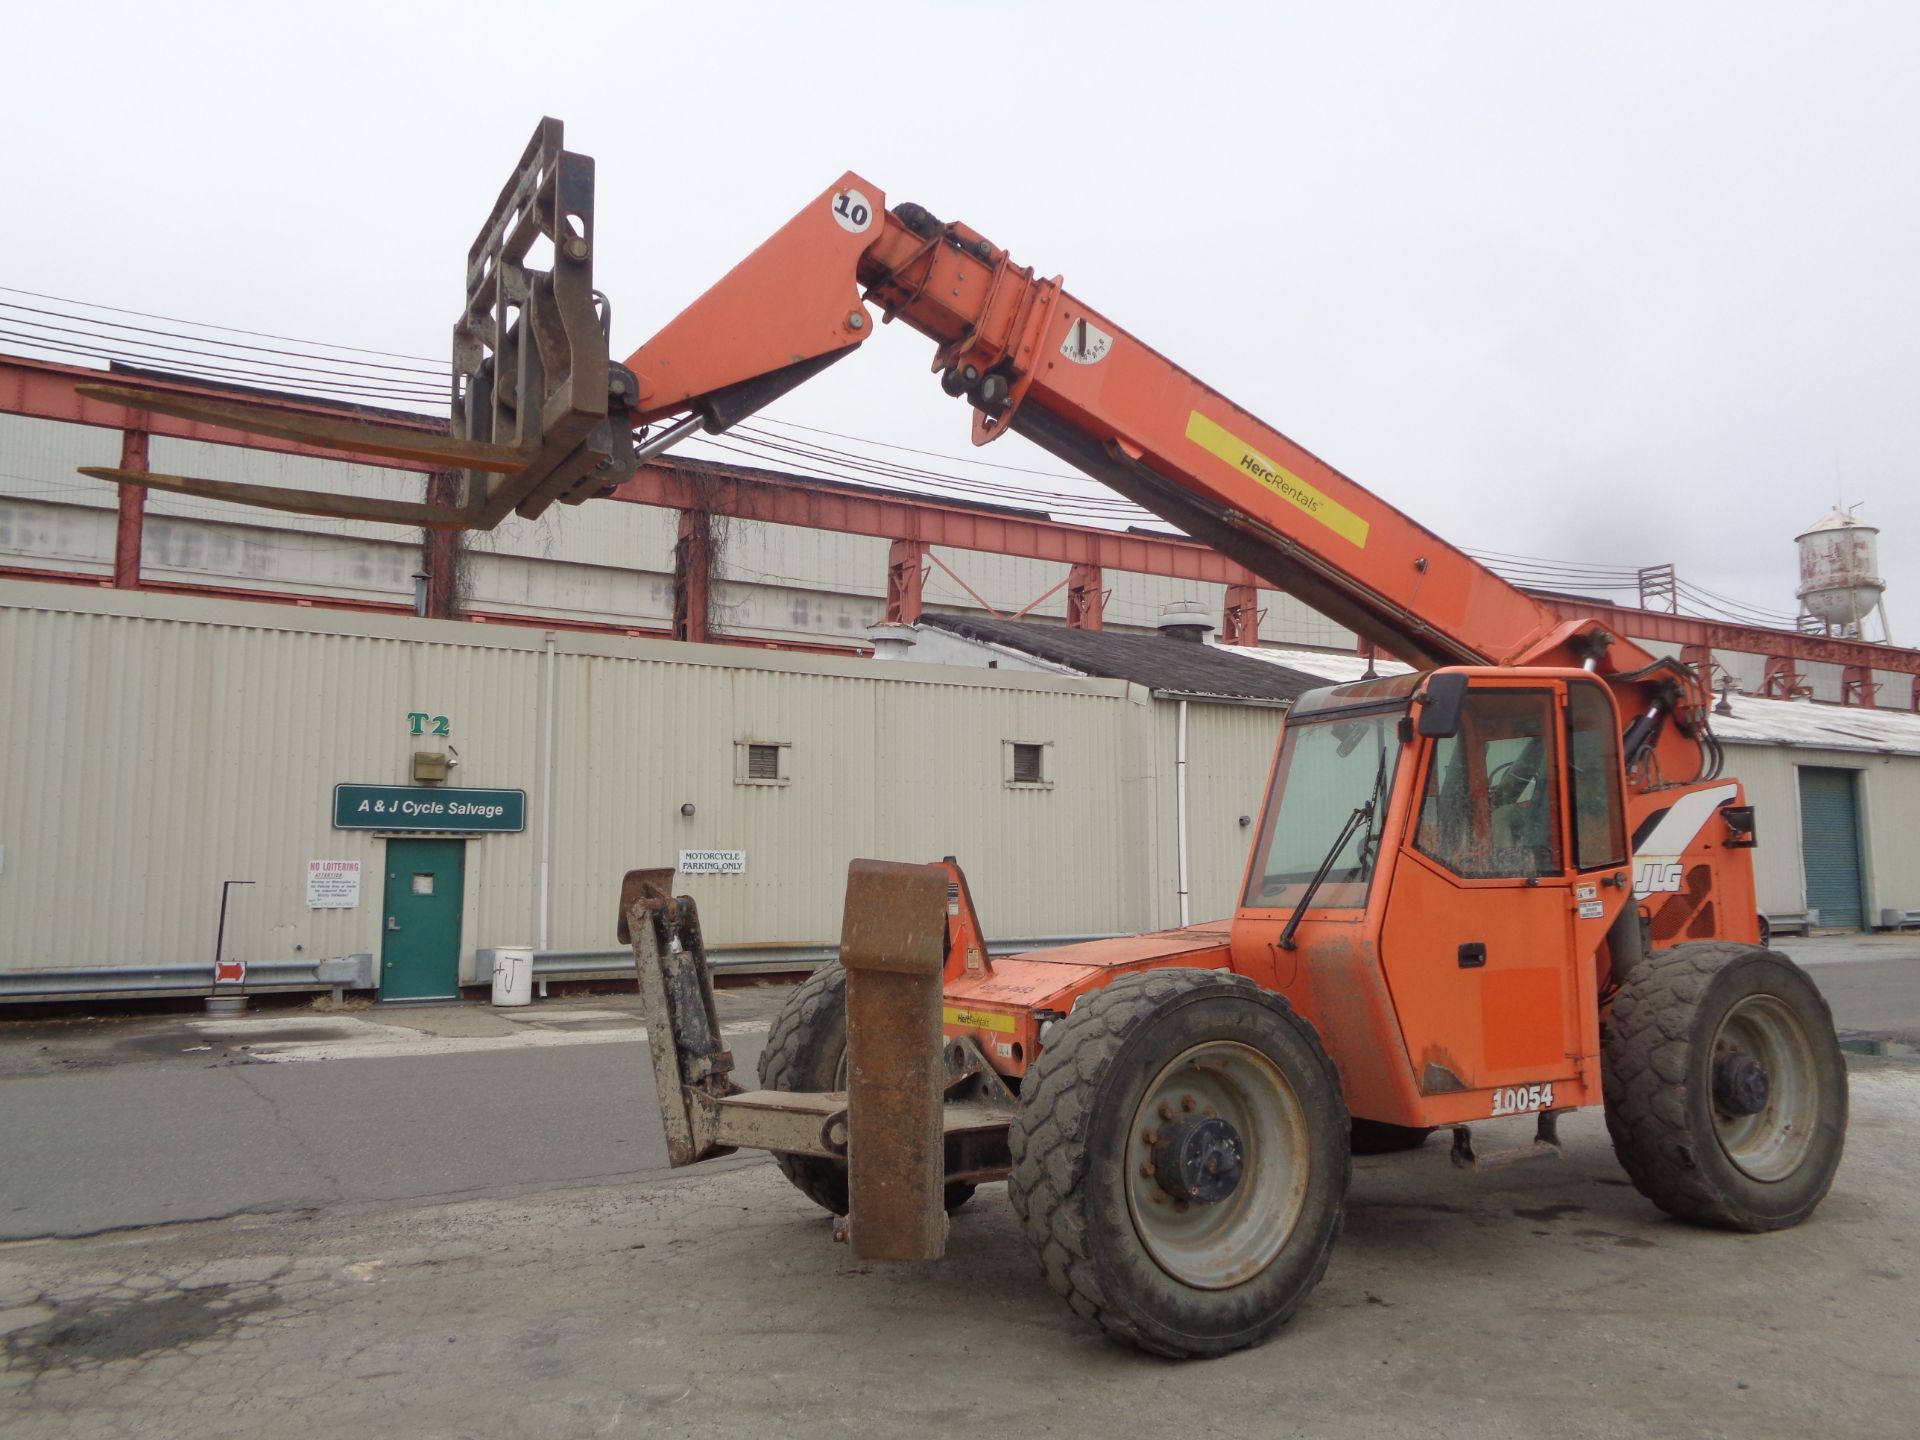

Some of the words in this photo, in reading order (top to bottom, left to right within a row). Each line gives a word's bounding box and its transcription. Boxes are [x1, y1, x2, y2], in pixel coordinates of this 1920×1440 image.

[834, 195, 868, 226] 10
[1240, 454, 1319, 512] HercRentals
[357, 800, 370, 812] A
[374, 800, 386, 813] &
[389, 800, 399, 813] J
[402, 801, 444, 816] Cycle
[448, 802, 504, 818] Salvage
[310, 862, 320, 871] NO
[323, 862, 359, 872] LOITERING
[683, 862, 719, 870] PARKING
[721, 862, 743, 870] ONLY
[685, 852, 740, 860] MOTORCYCLE
[1633, 863, 1684, 893] JLG
[1492, 1082, 1553, 1116] 10054
